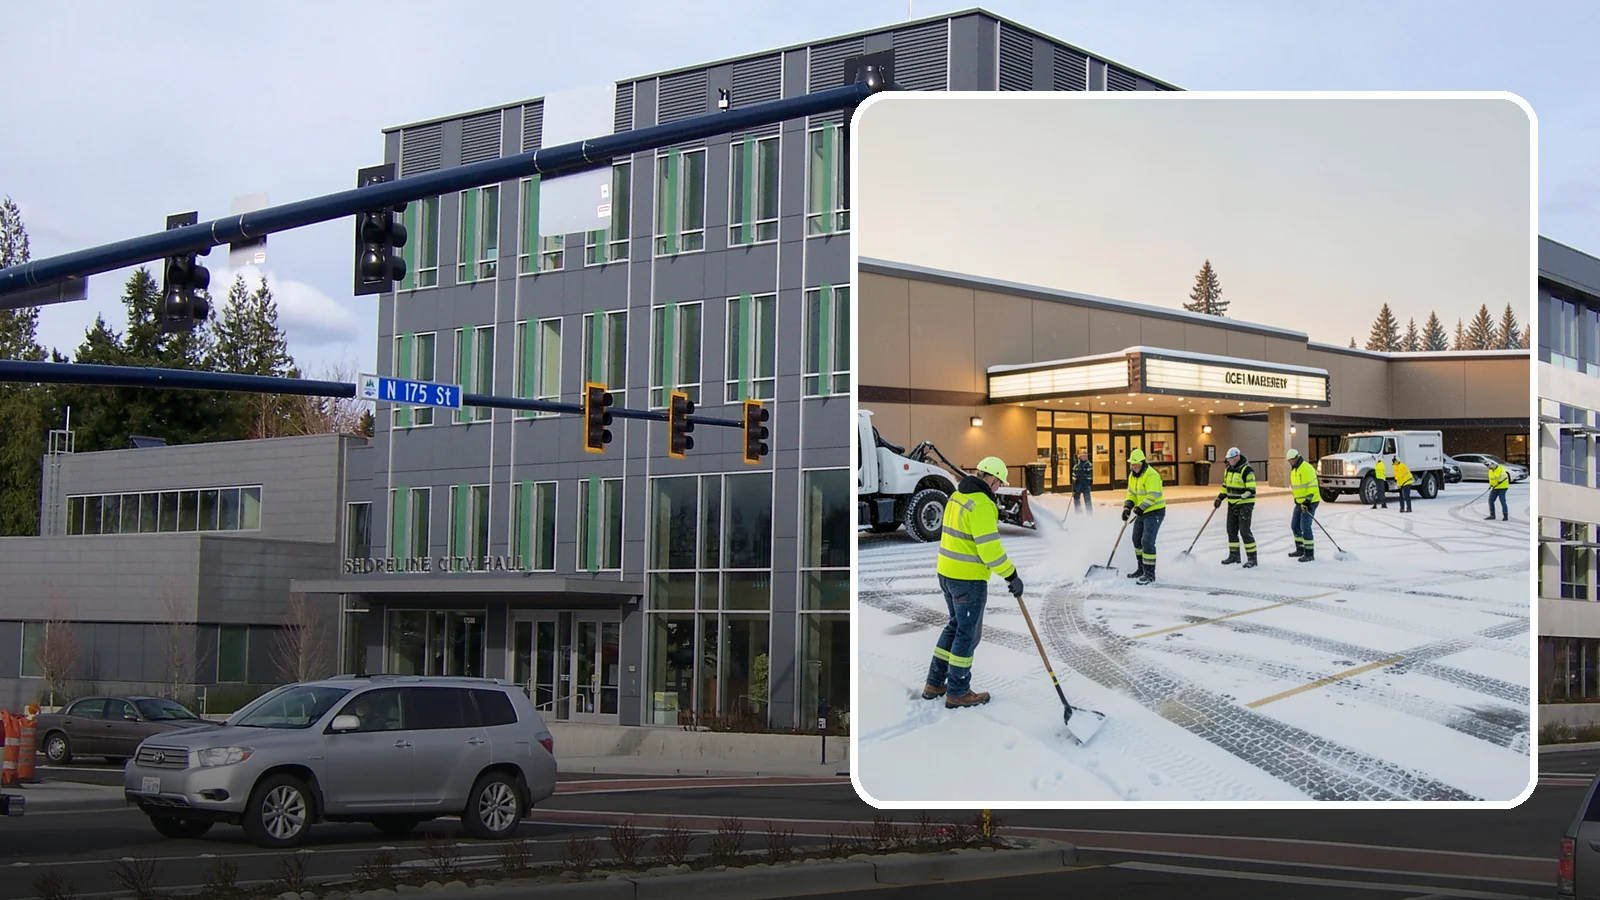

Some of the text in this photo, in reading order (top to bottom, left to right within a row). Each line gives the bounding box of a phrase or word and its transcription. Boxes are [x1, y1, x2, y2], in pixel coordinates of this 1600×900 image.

[387, 380, 451, 406] N 175 St
[344, 555, 524, 574] SHORELINE CITY HALL
